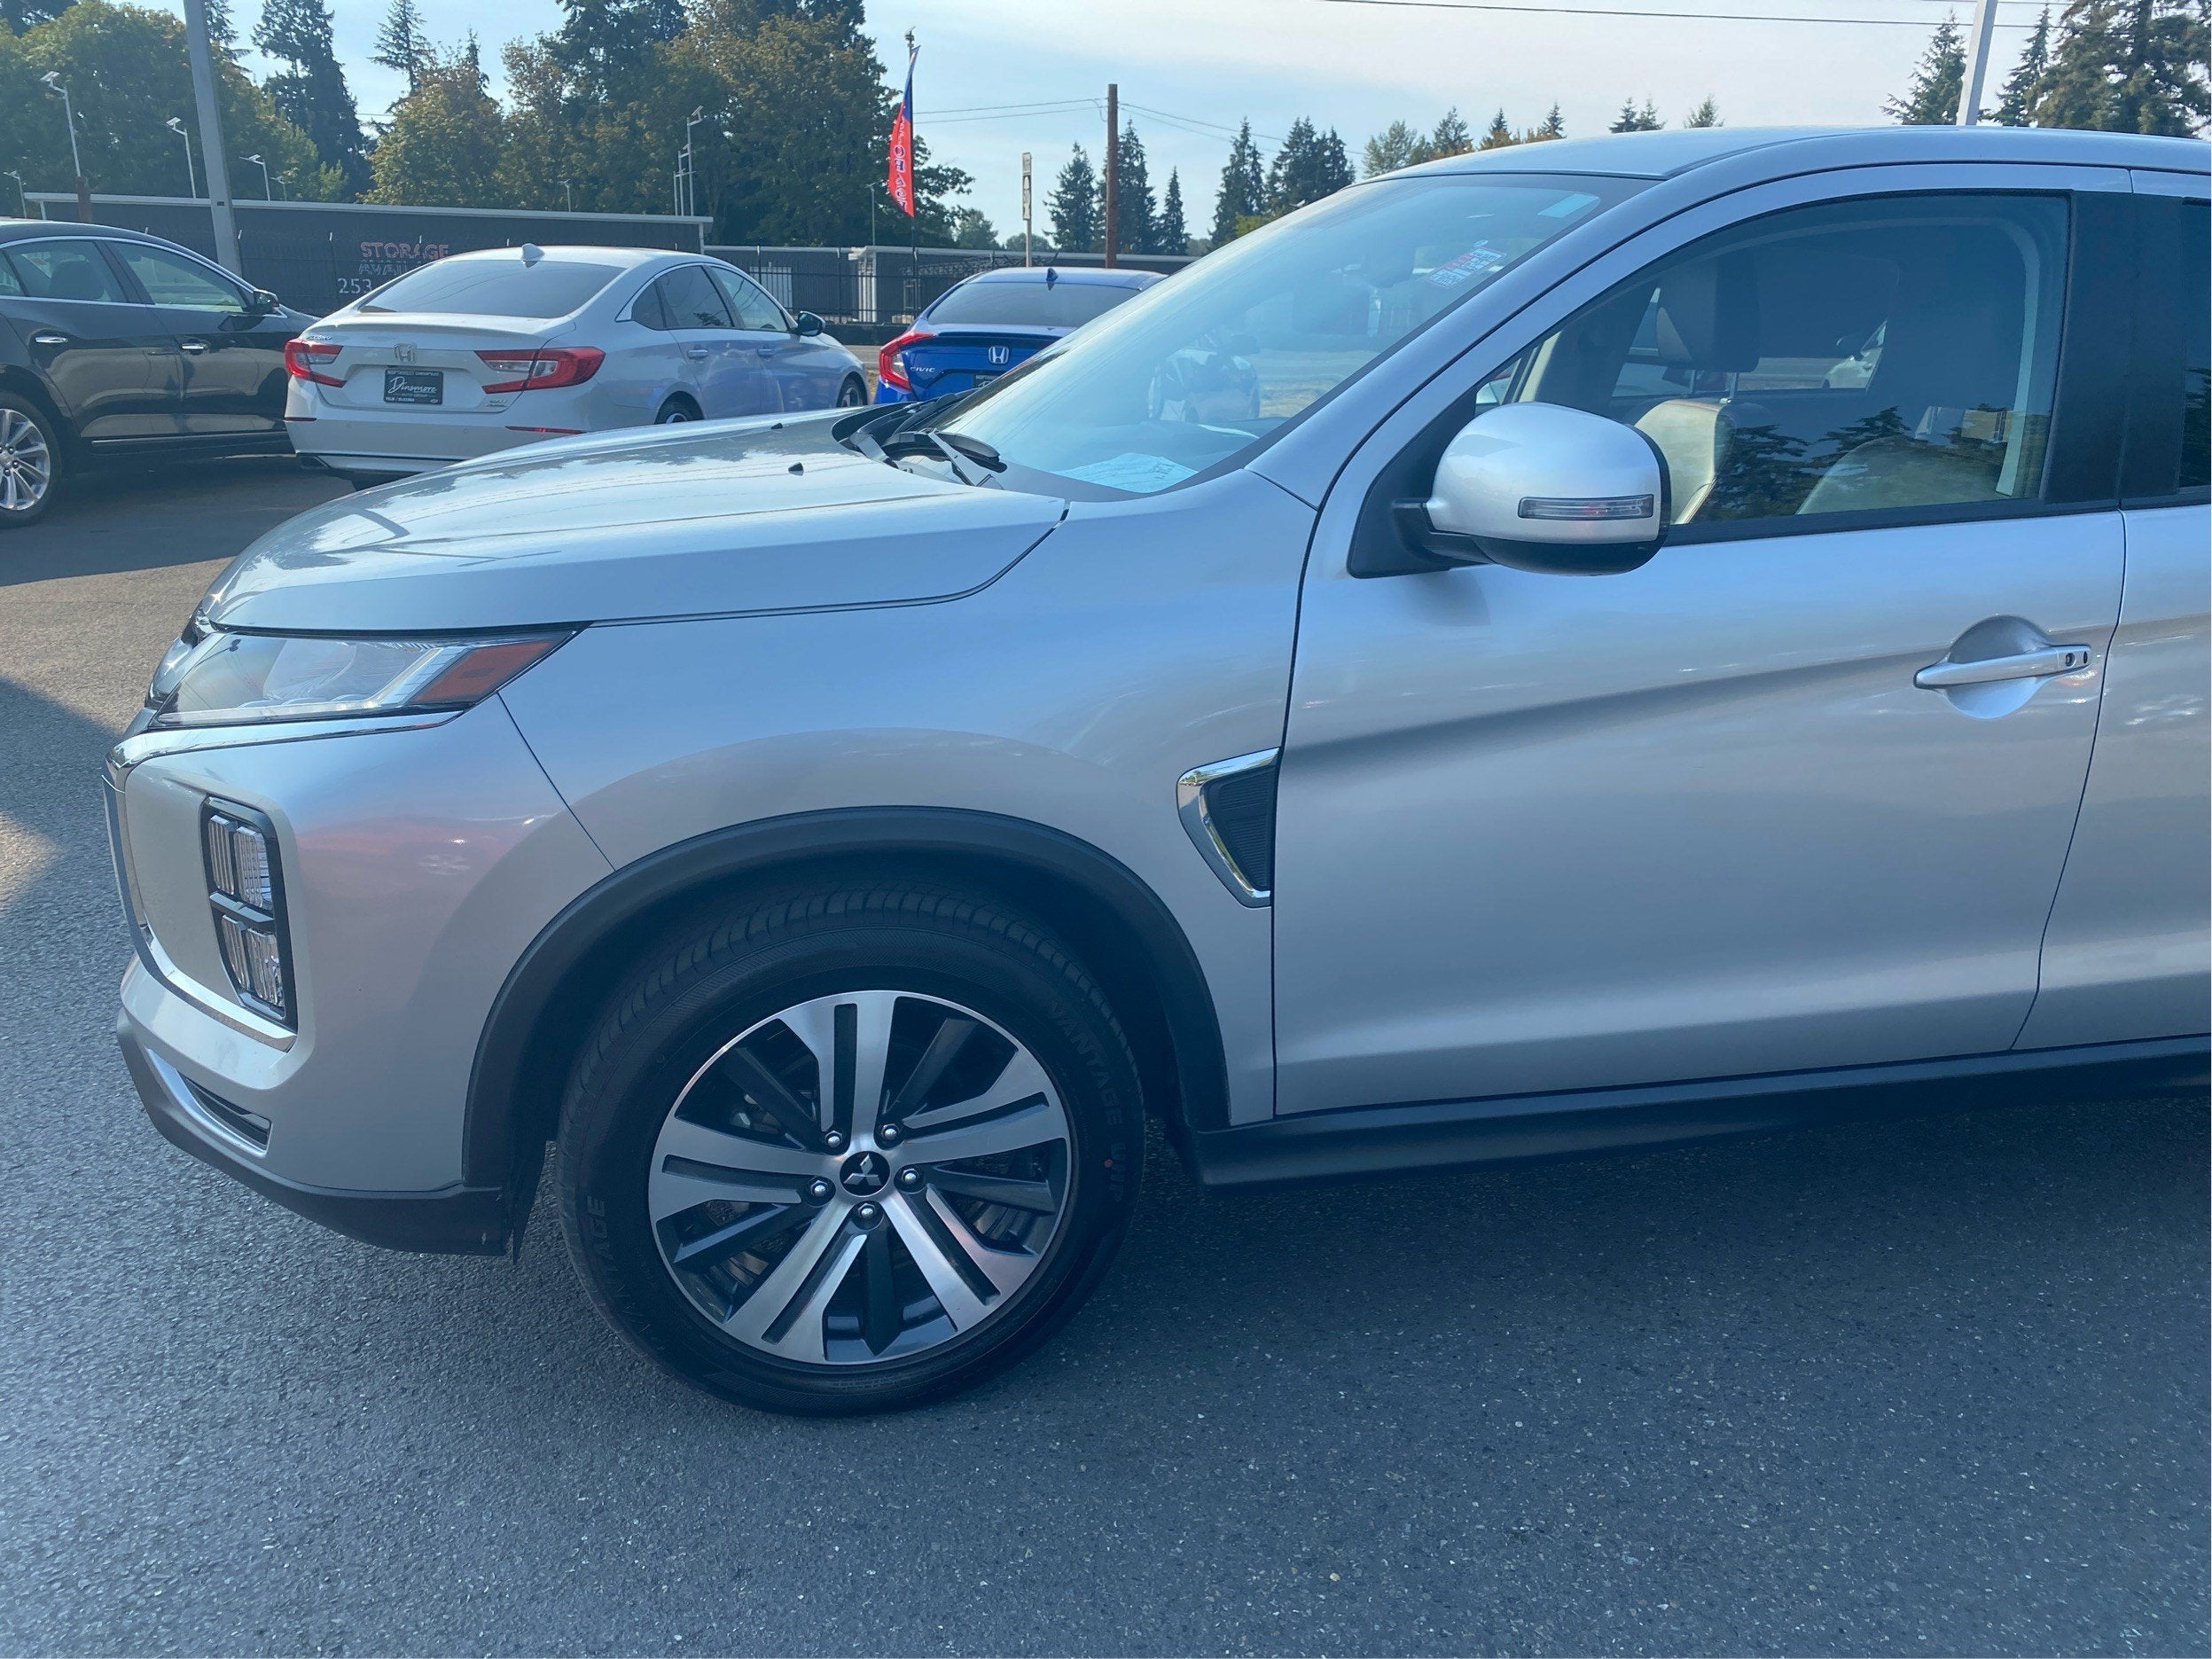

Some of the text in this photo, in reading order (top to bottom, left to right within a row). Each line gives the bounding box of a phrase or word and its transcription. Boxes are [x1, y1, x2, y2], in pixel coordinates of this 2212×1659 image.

[360, 241, 449, 260] STORAGE
[338, 278, 372, 294] 253
[1048, 998, 1123, 1127] VANTAGE
[1109, 1141, 1127, 1203] UHP
